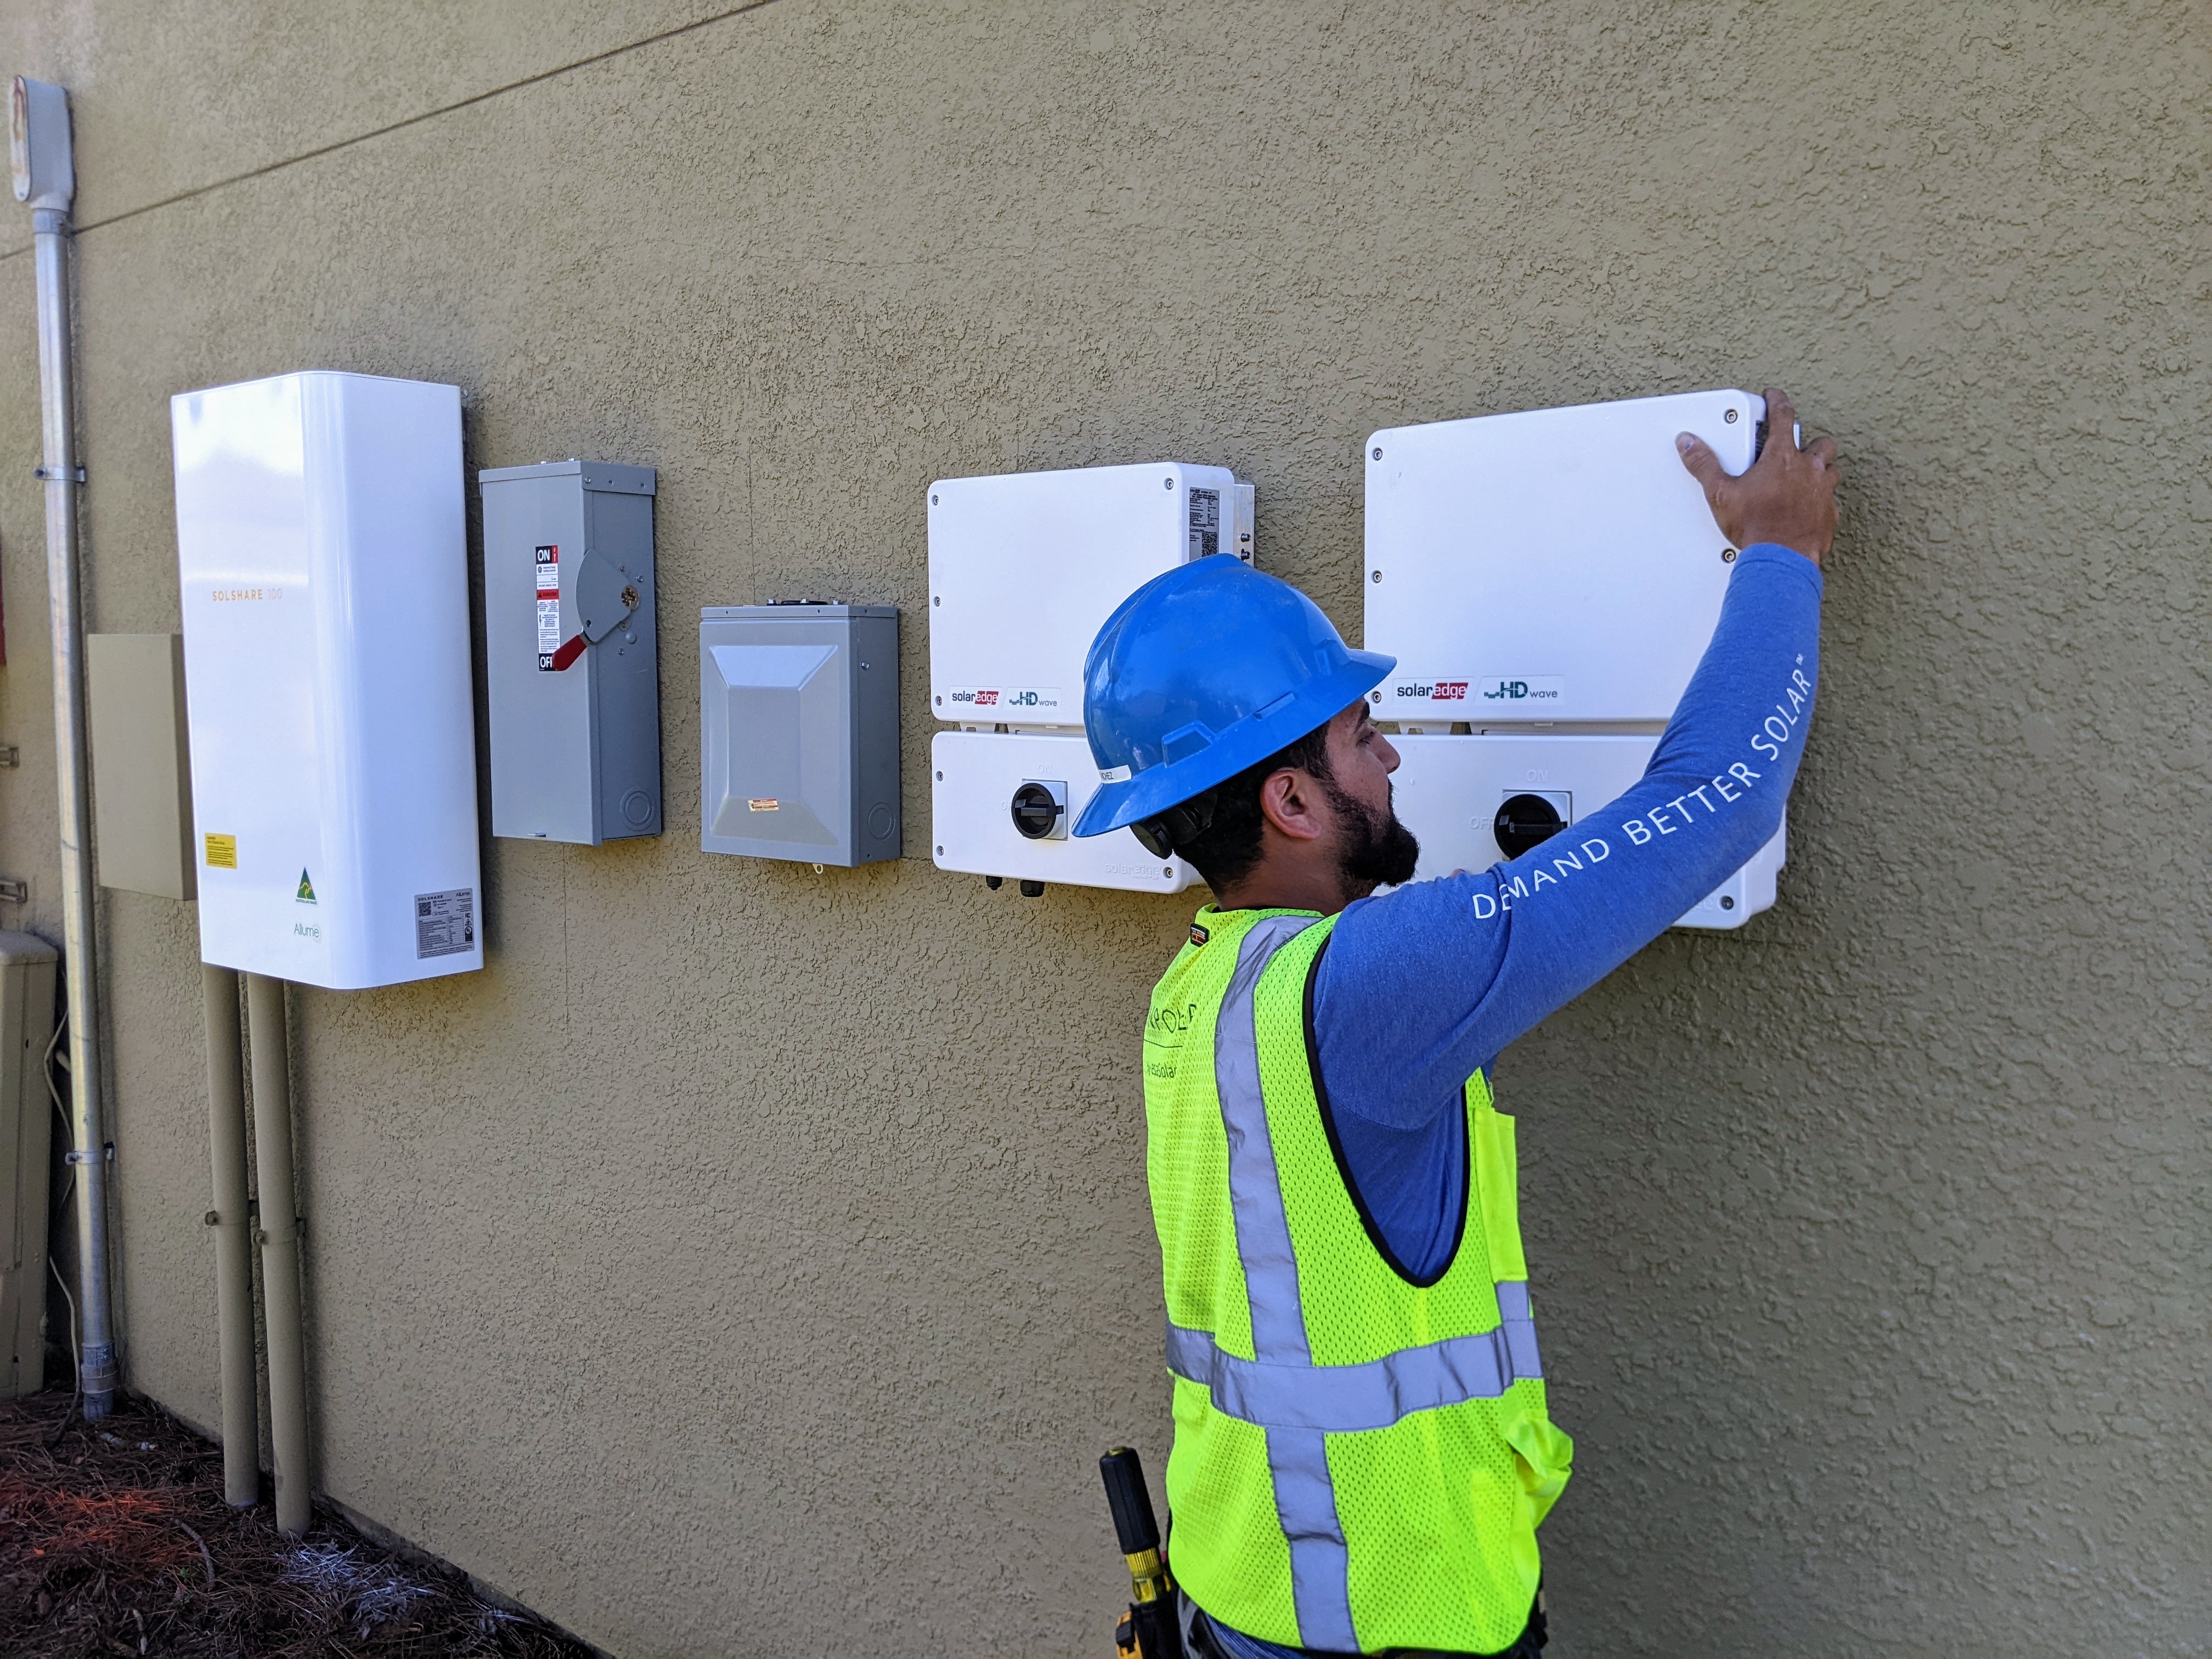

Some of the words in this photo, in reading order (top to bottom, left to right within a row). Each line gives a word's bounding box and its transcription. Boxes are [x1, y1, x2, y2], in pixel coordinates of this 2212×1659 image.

[538, 549, 550, 561] ON
[212, 589, 263, 601] SOLSHARE
[267, 588, 283, 600] 100
[1397, 682, 1469, 700] solaredge
[1500, 681, 1528, 699] HD
[1529, 690, 1558, 698] wave
[952, 690, 999, 706] solaredge
[1526, 769, 1549, 782] ON
[1621, 761, 1761, 845] BETTER
[294, 923, 319, 938] Allume
